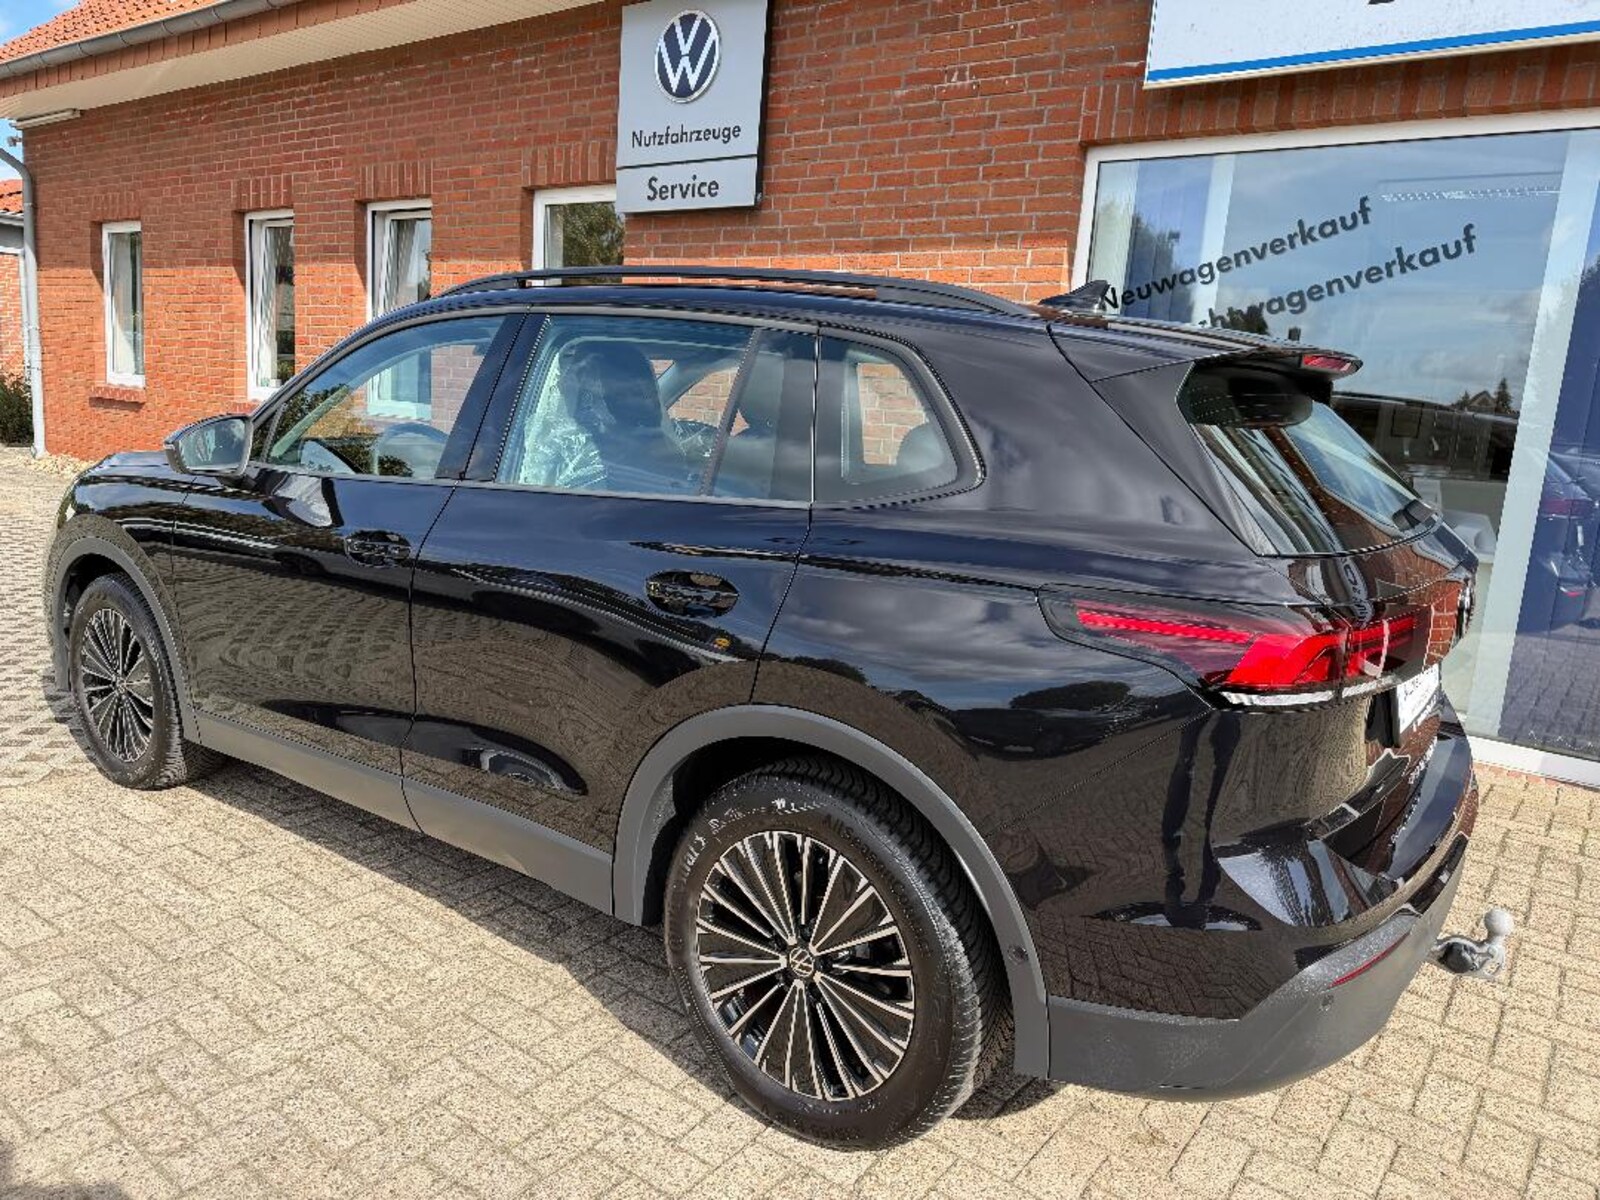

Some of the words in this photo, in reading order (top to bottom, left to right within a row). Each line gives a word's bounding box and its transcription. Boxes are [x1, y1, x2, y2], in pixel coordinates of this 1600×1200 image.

[632, 124, 742, 148] Nutzfahrzeuge
[647, 174, 720, 201] Service
[1101, 196, 1372, 312] Neuwagenverkauf
[1199, 223, 1477, 330] htwagenverkauf
